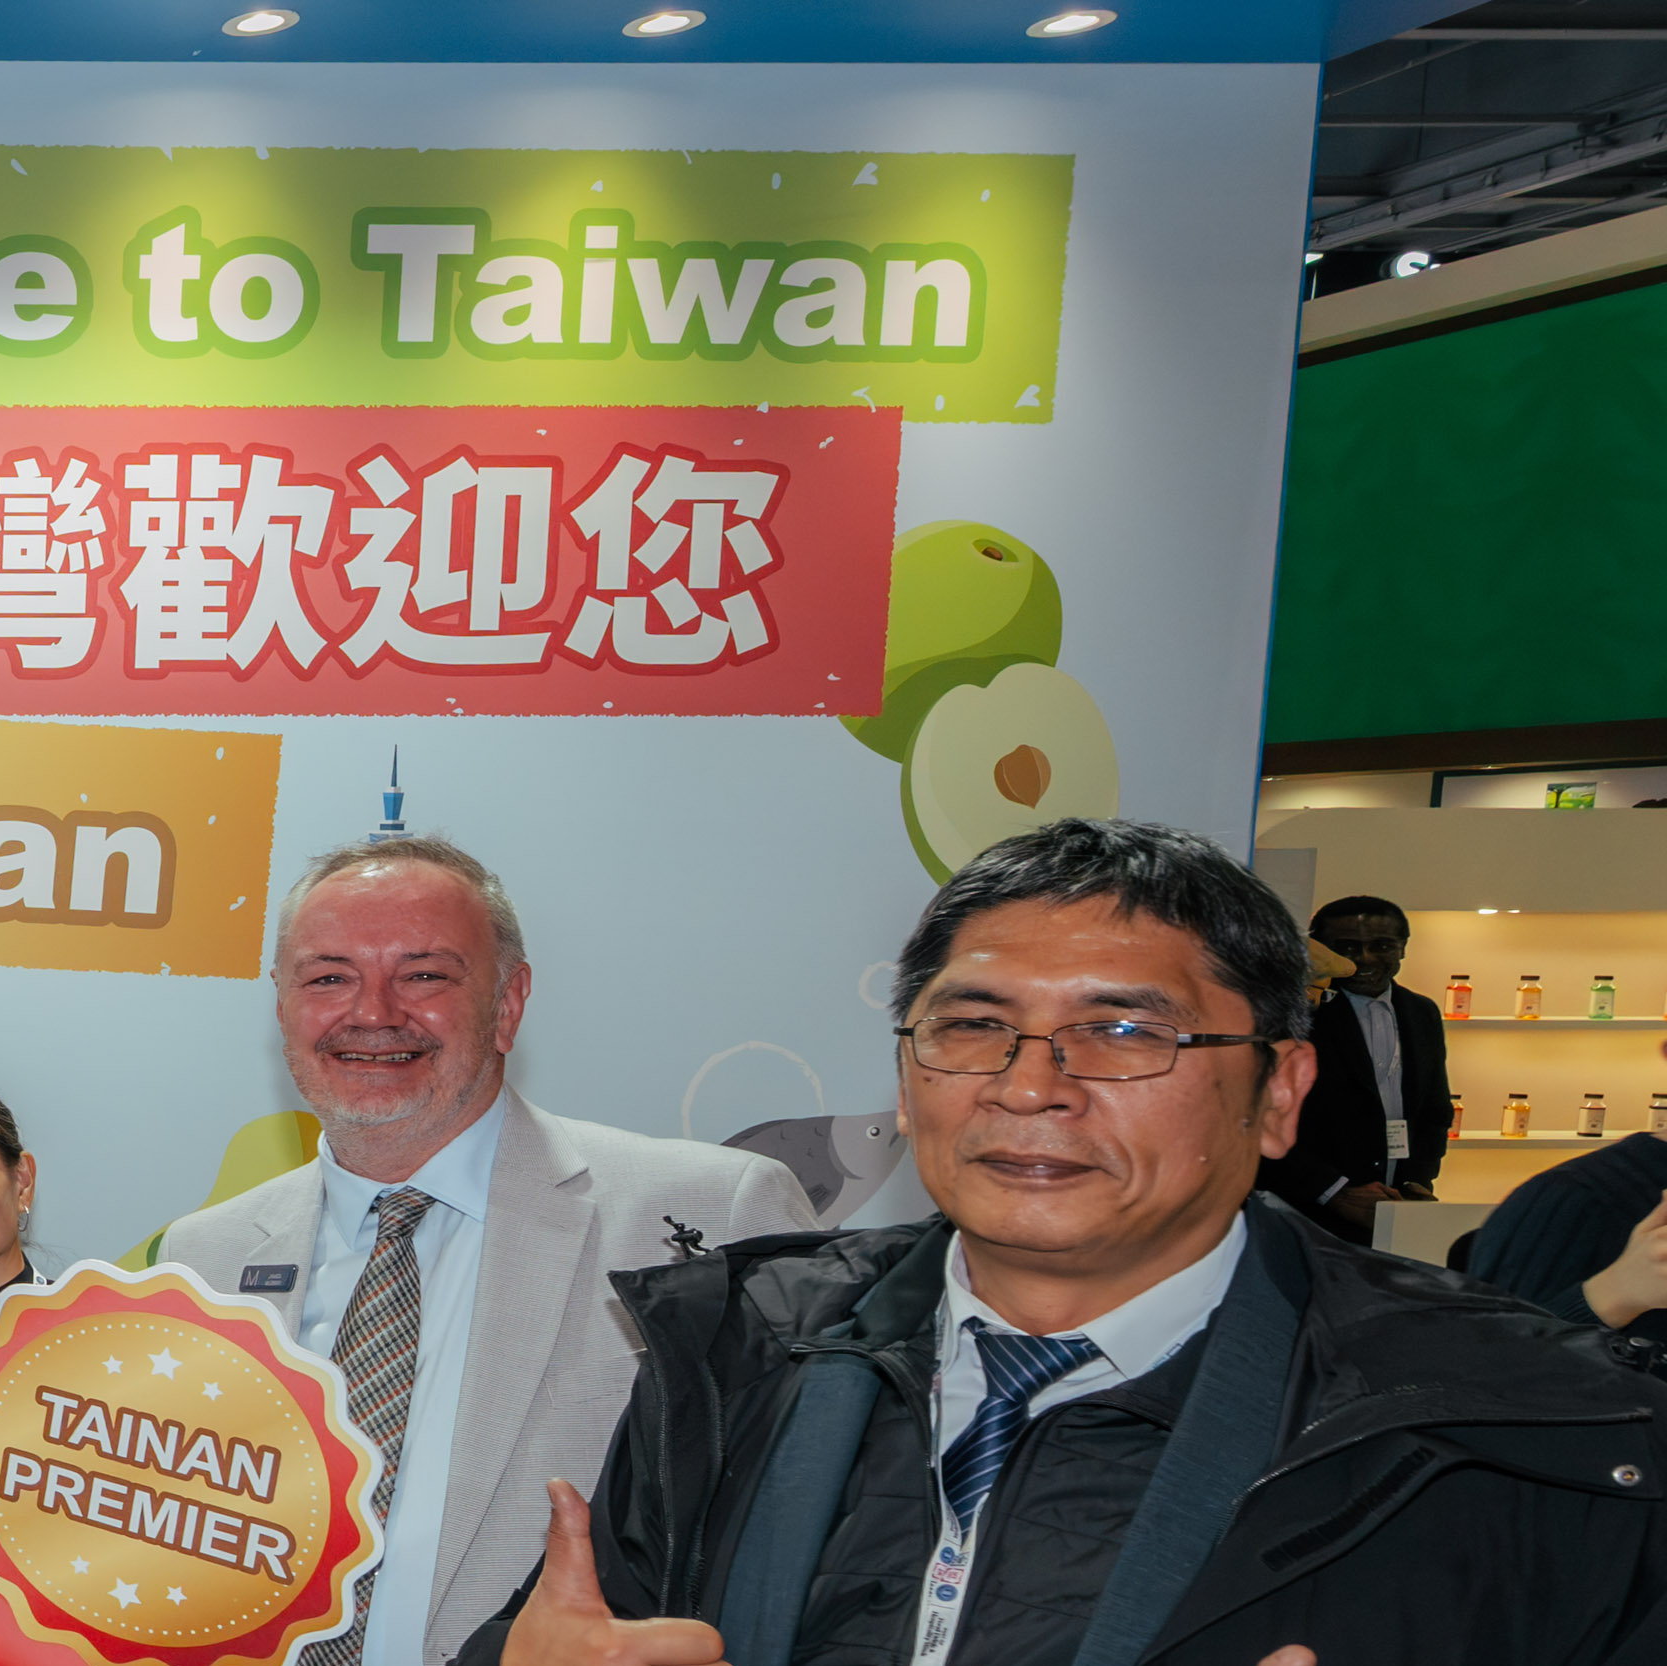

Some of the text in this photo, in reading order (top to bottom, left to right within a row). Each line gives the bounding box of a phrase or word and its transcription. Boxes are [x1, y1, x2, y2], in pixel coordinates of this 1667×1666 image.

[141, 218, 307, 346] to
[367, 221, 975, 350] Taiwan
[40, 1391, 276, 1499] TAINAN
[4, 1453, 295, 1580] PREMIER
